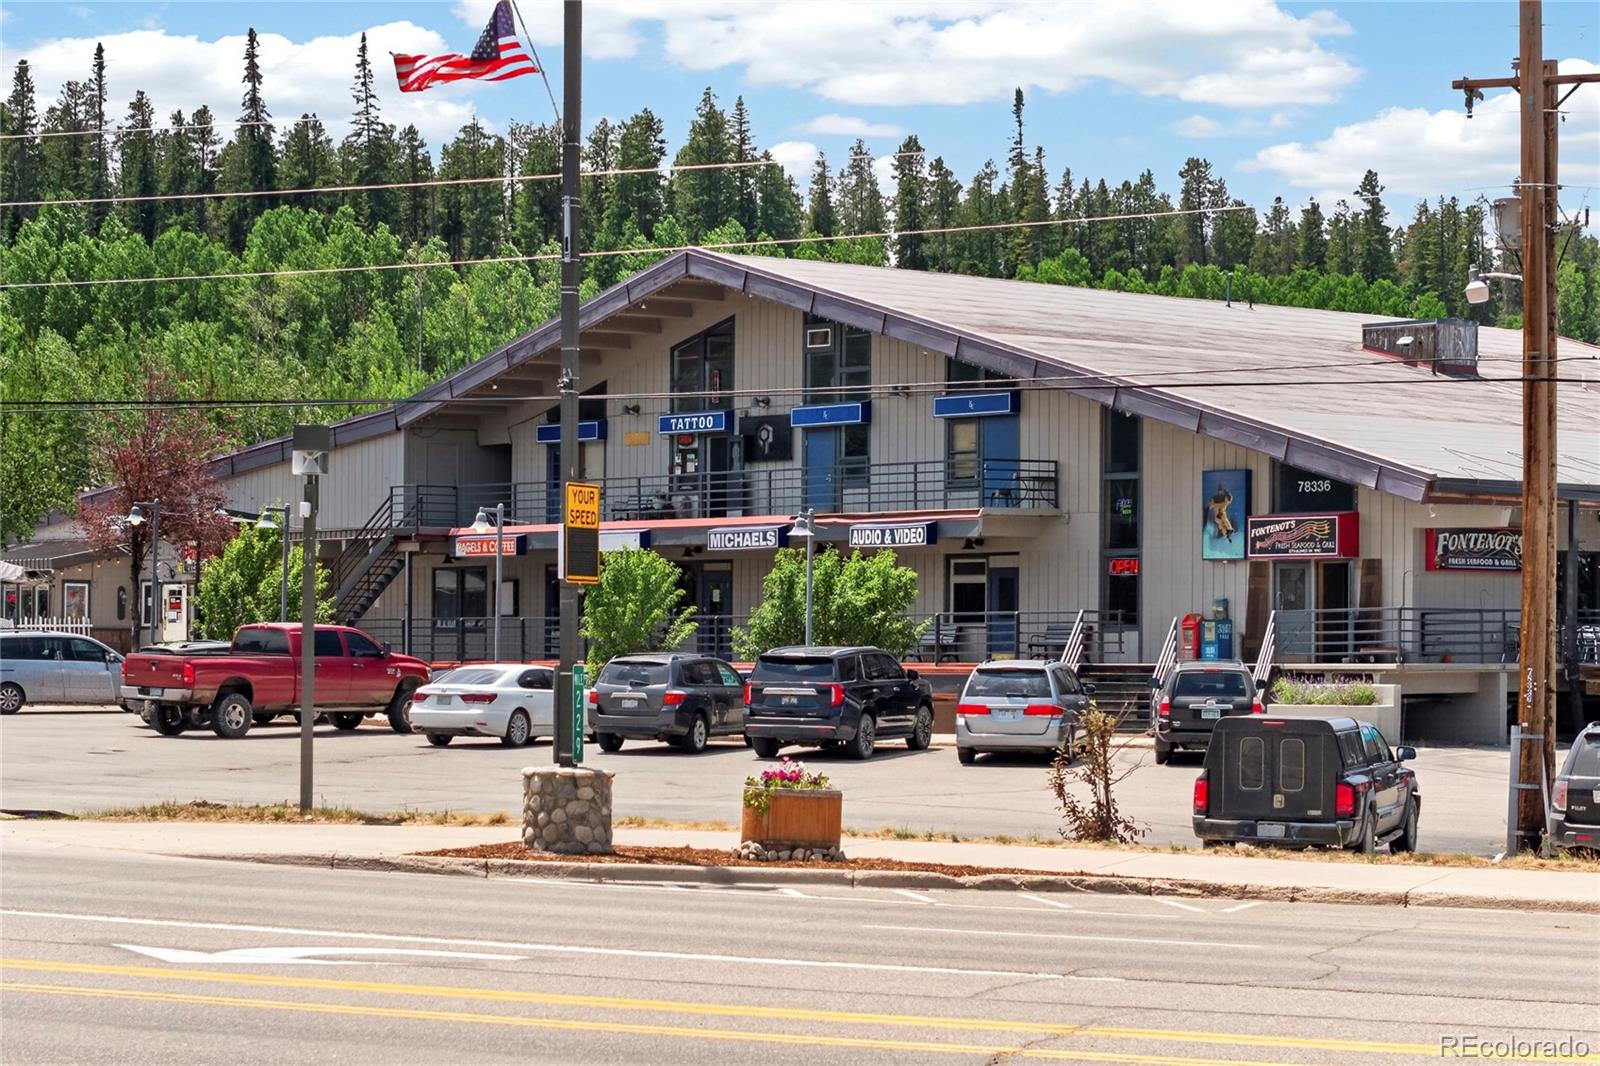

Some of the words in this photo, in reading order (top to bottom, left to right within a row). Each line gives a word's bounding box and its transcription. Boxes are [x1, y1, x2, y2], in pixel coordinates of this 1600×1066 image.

[670, 416, 714, 430] TATTOO
[1297, 480, 1331, 492] 78336
[572, 489, 595, 505] YOUR
[570, 508, 597, 525] SPEED
[710, 531, 776, 548] MICHAELS
[852, 529, 881, 545] AUDIO
[884, 529, 892, 544] &
[894, 528, 923, 544] VIDEO
[1112, 559, 1138, 573] OPEN
[1448, 557, 1466, 565] FRESH
[1466, 557, 1493, 566] SEAFOOD
[1500, 559, 1517, 567] GRILL
